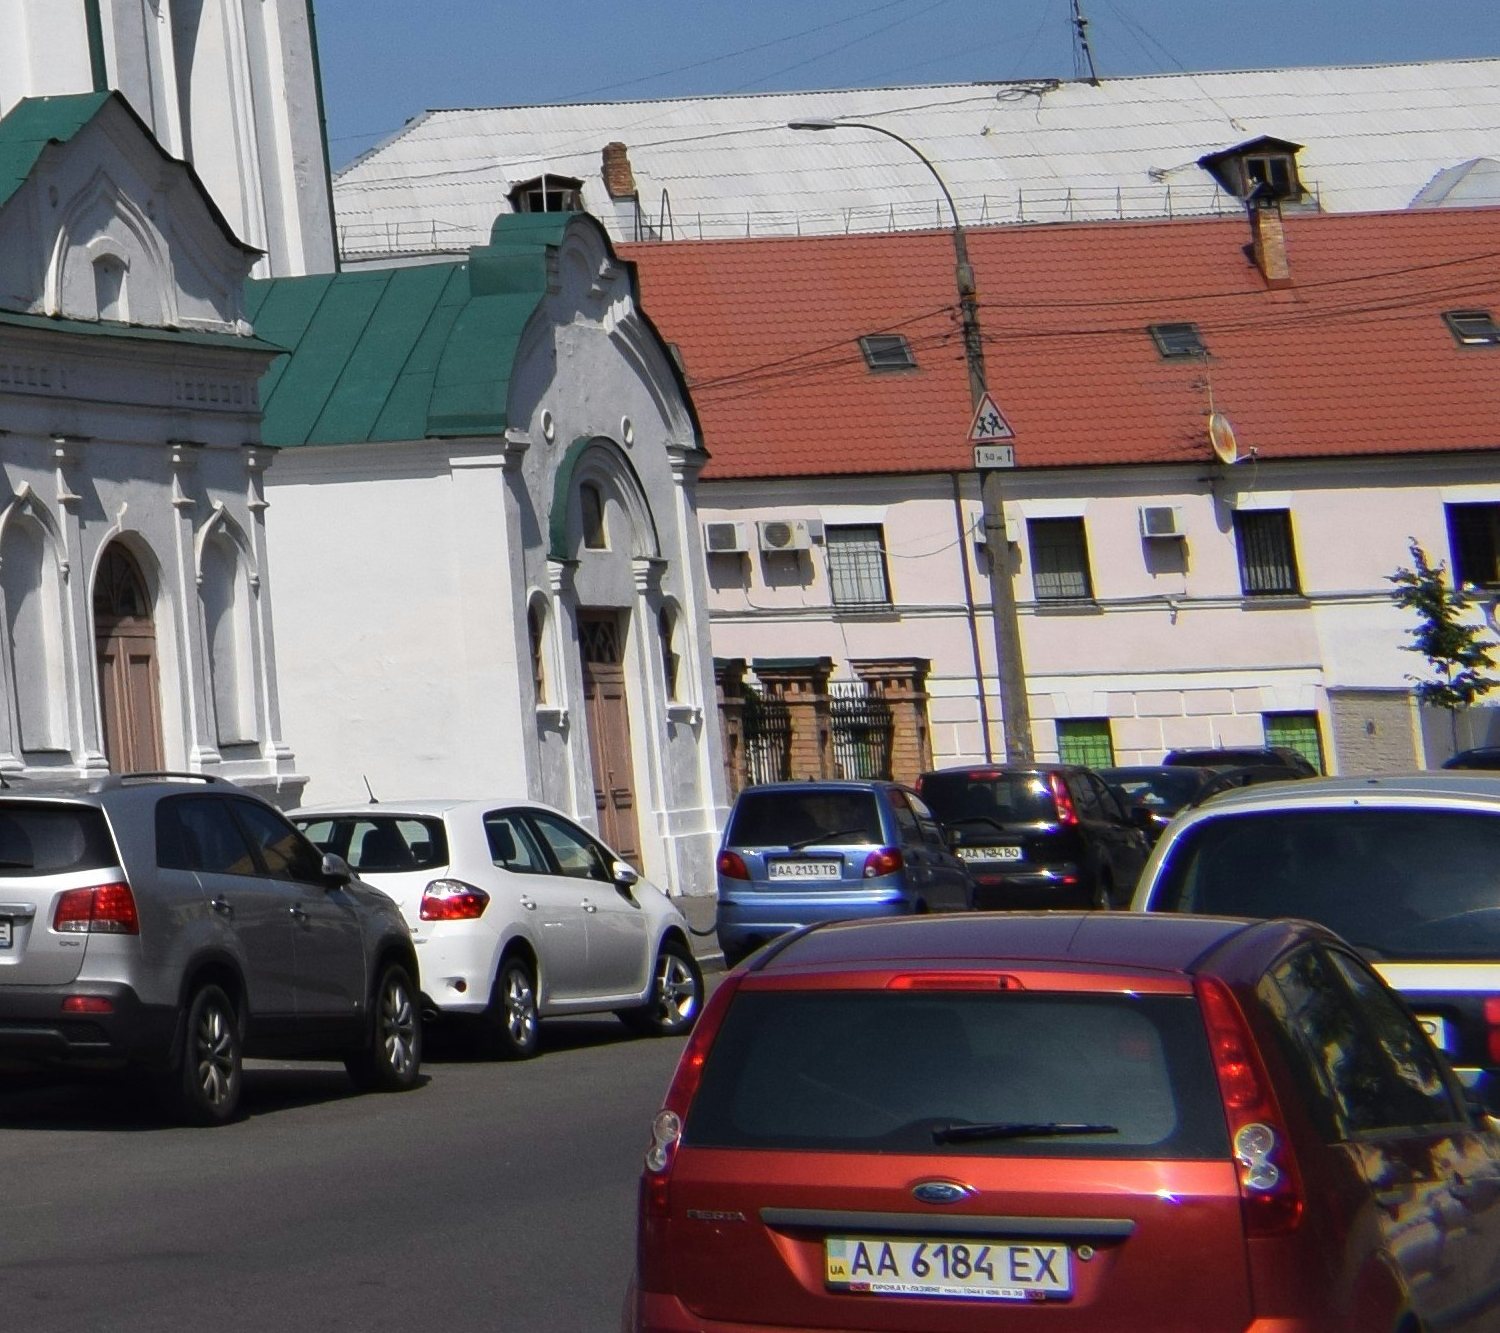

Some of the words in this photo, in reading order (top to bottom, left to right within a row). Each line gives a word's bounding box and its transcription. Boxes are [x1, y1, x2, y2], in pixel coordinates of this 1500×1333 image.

[778, 865, 793, 875] AA
[795, 864, 819, 876] 2133
[822, 864, 837, 876] TB
[850, 1241, 900, 1277] AA
[911, 1242, 994, 1281] 6184
[1009, 1246, 1060, 1283] EX
[829, 1264, 846, 1276] UA
